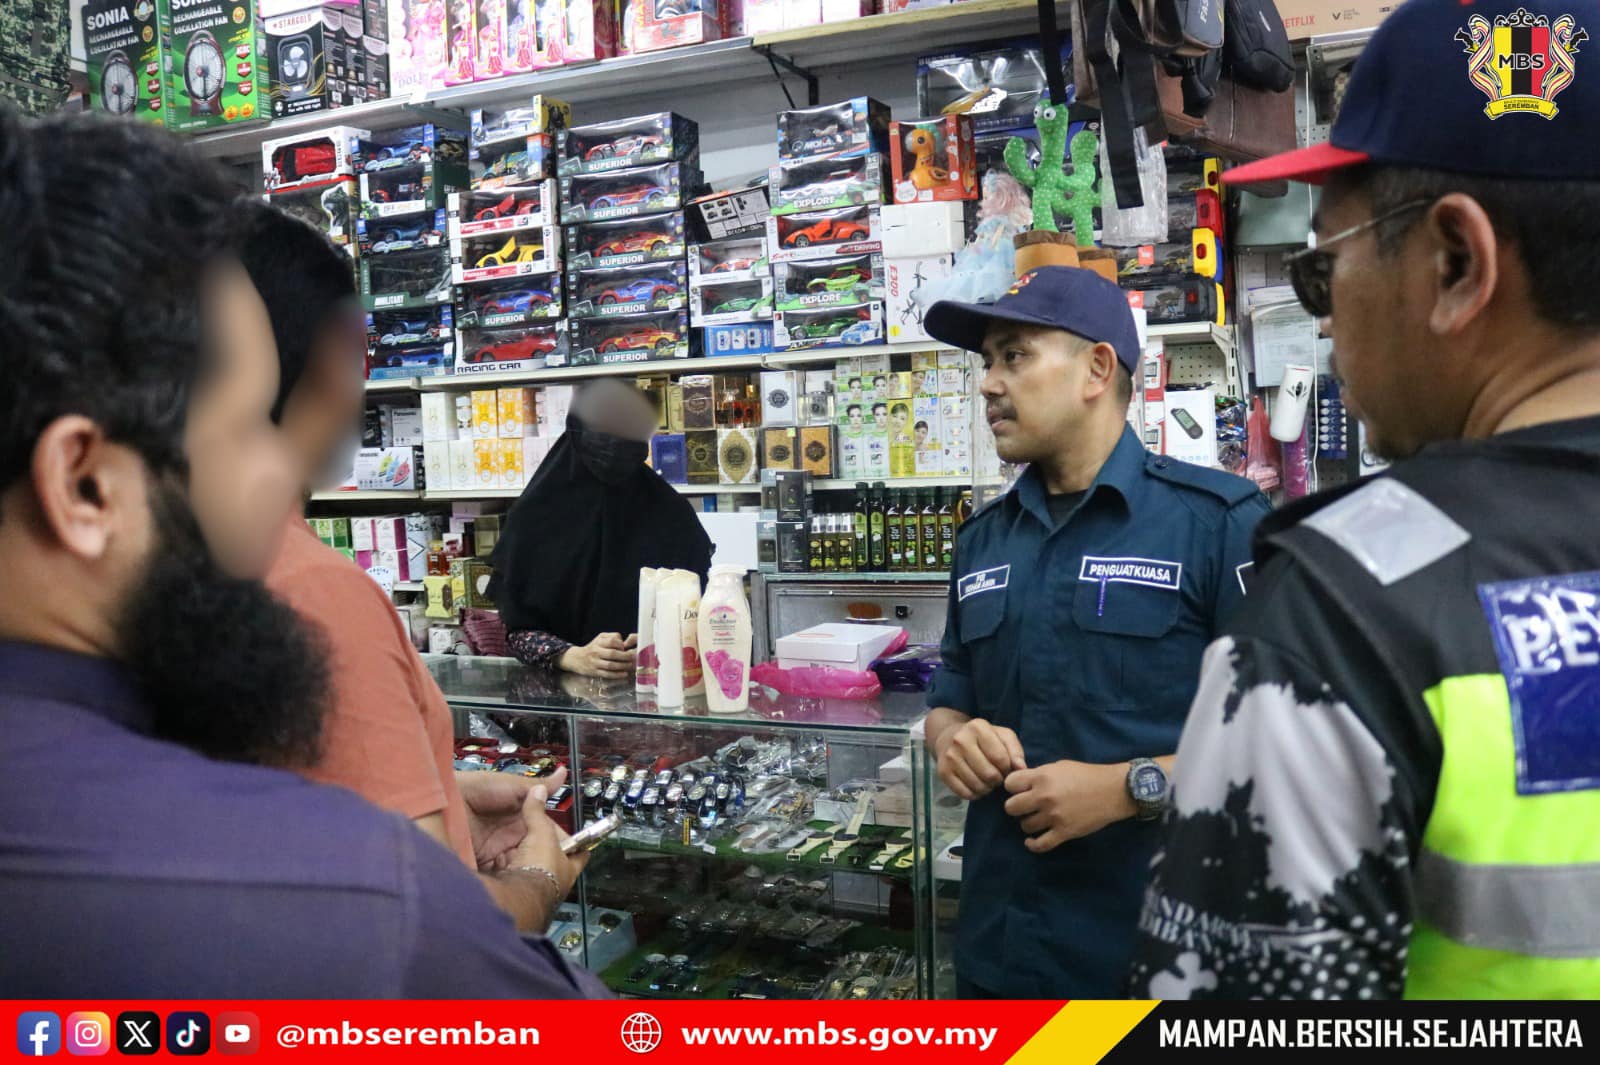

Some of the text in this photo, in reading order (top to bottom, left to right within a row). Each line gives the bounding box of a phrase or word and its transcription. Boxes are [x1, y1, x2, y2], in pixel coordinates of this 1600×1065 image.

[87, 6, 129, 31] SONIA
[278, 14, 312, 28] STARGOLD
[1283, 15, 1315, 28] ETFLIX
[588, 158, 632, 172] SUPERIOR
[793, 196, 836, 208] EXPLORE
[593, 207, 639, 219] SUPERIOR
[599, 254, 644, 267] SUPERIOR
[889, 264, 899, 297] E300
[799, 293, 841, 305] EXPLORE
[601, 303, 646, 315] SUPERIOR
[484, 313, 525, 325] SUPERIOR
[603, 352, 648, 363] SUPERIOR
[457, 362, 521, 373] RACING CAR
[1089, 563, 1171, 583] PENGUATKUASA
